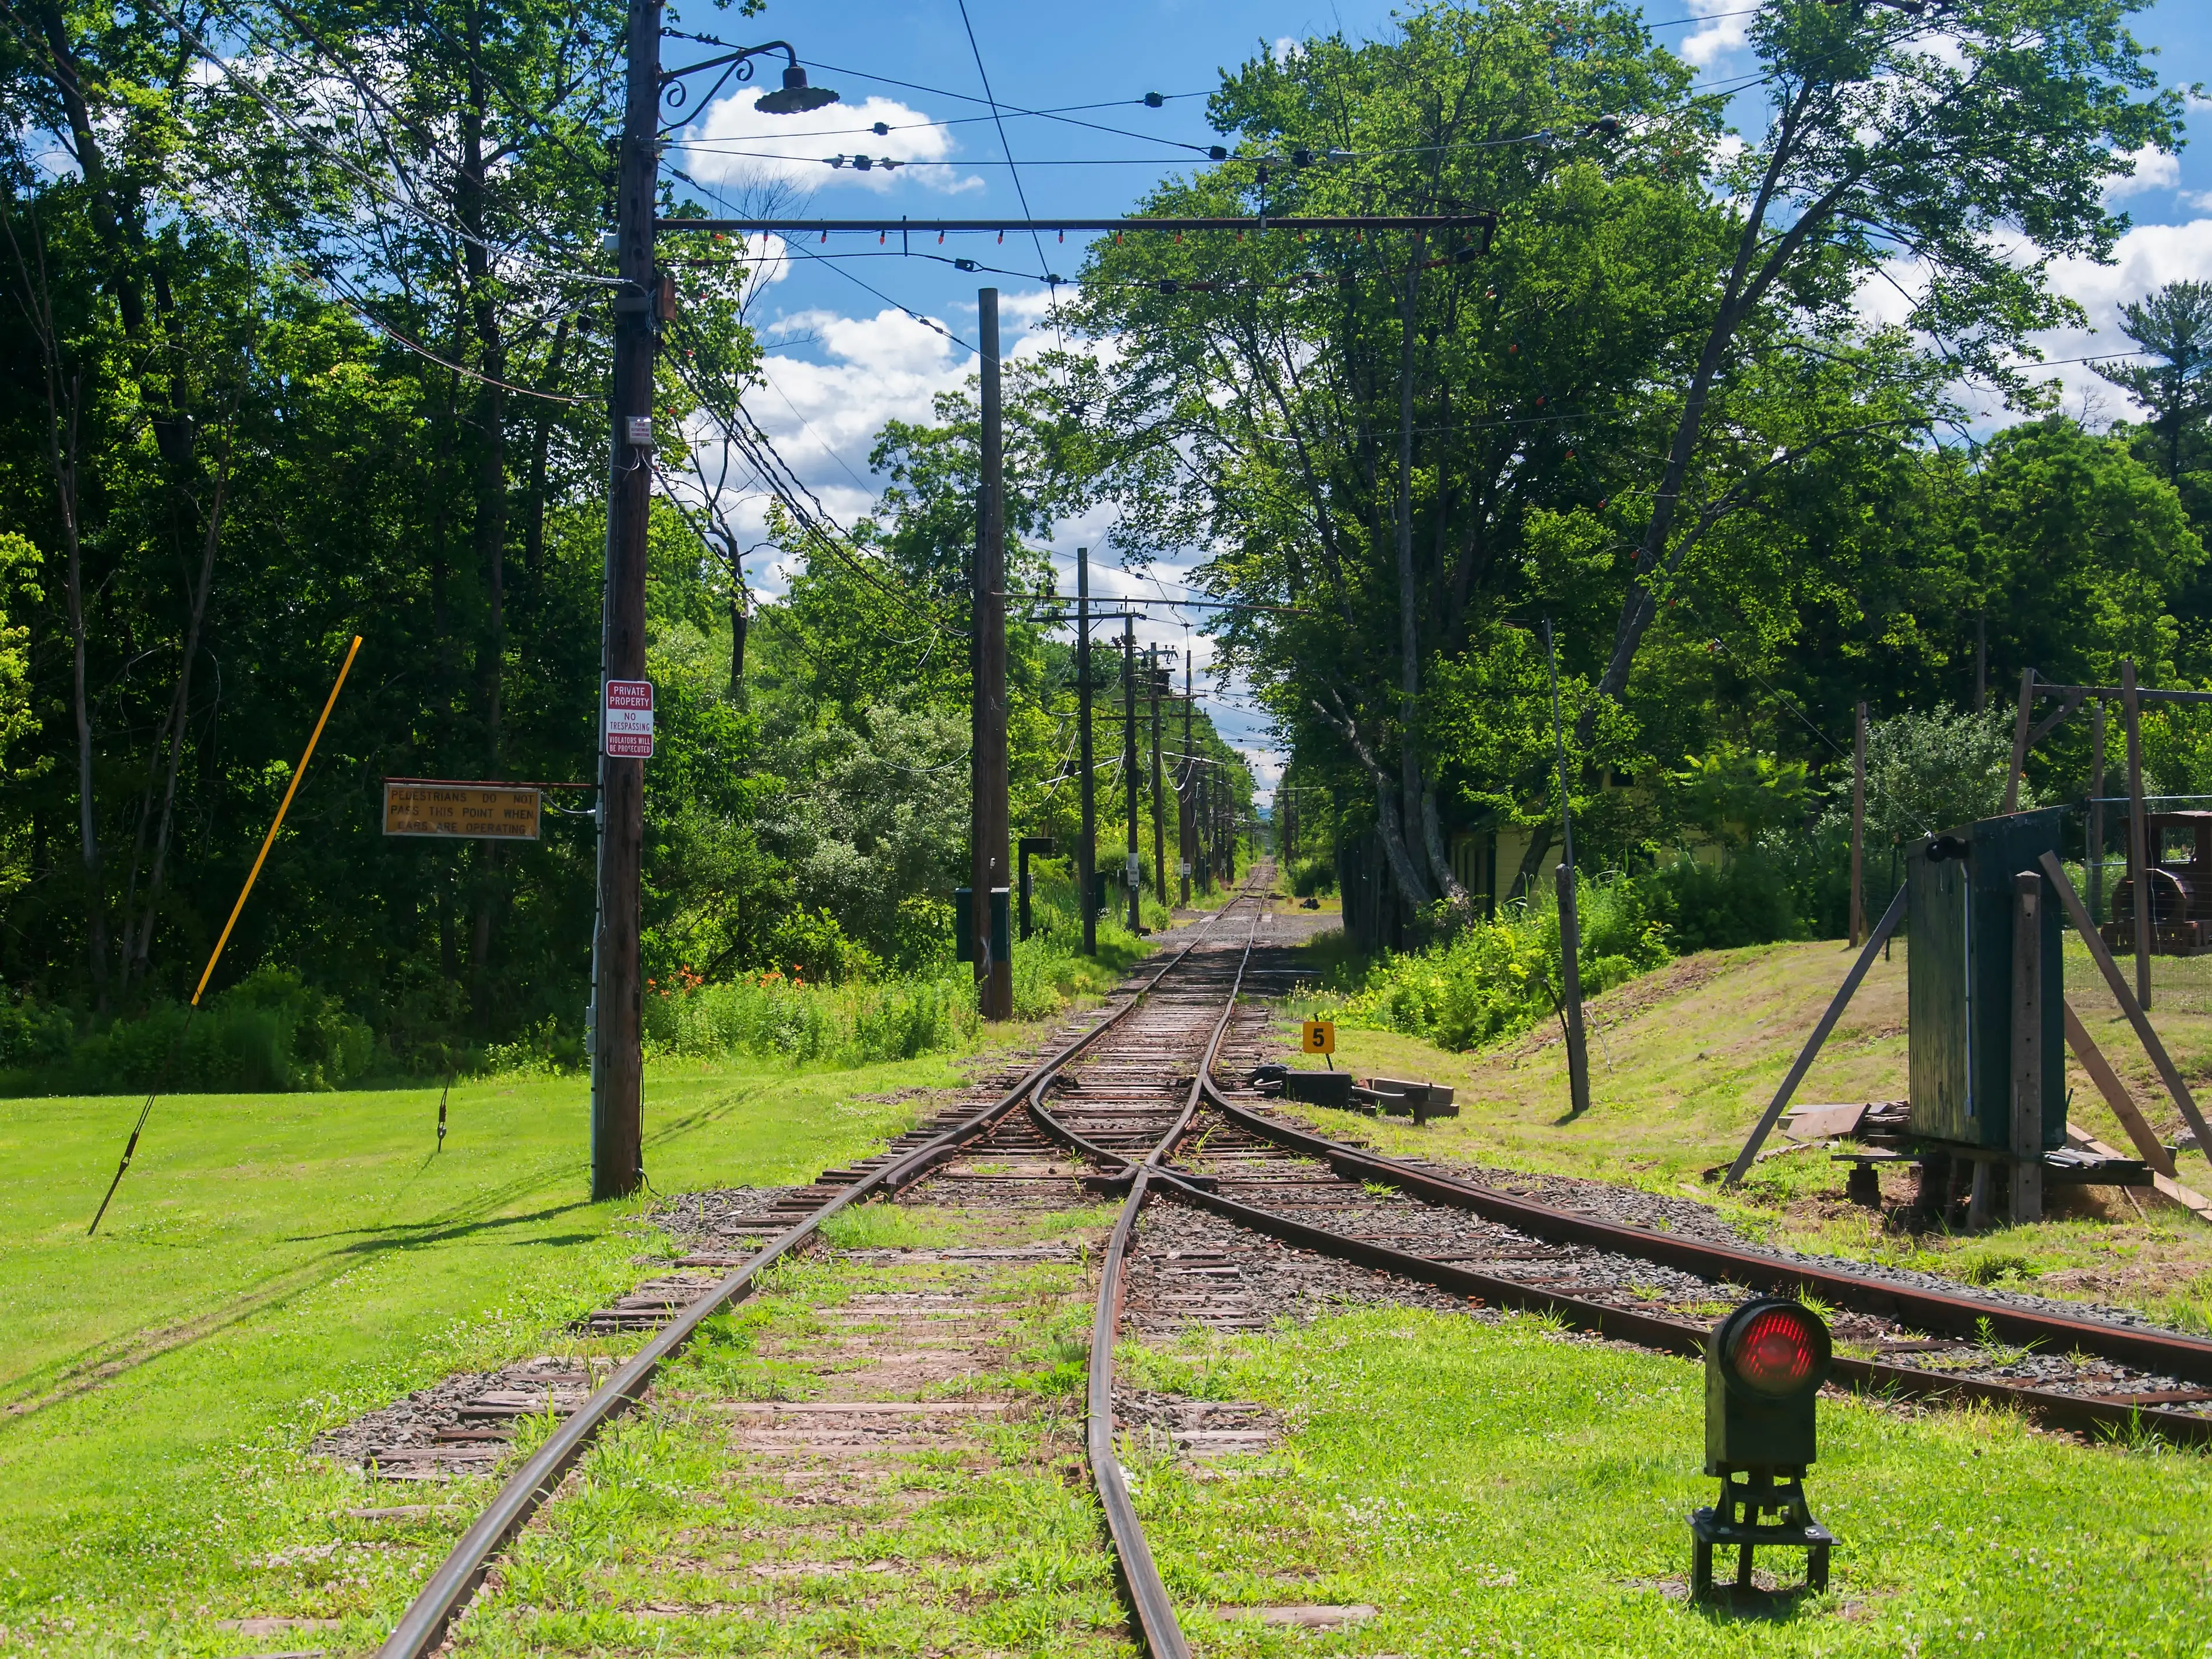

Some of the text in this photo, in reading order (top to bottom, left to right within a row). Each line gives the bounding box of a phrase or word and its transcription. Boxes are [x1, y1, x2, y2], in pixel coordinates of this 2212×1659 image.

[613, 686, 645, 696] PRIVATE
[610, 697, 649, 707] PROPERTY
[624, 712, 636, 721] NO
[610, 722, 650, 732] TRESPASSING
[609, 736, 650, 745] VIOLATORS WILL
[618, 745, 650, 753] PROSECUTED
[391, 790, 534, 805] PEDESTRIANS DO NOT
[390, 805, 534, 820] PASS THIS POINT WHEN
[398, 820, 525, 835] CARS ARE OPERATING
[1313, 1028, 1325, 1047] 5
